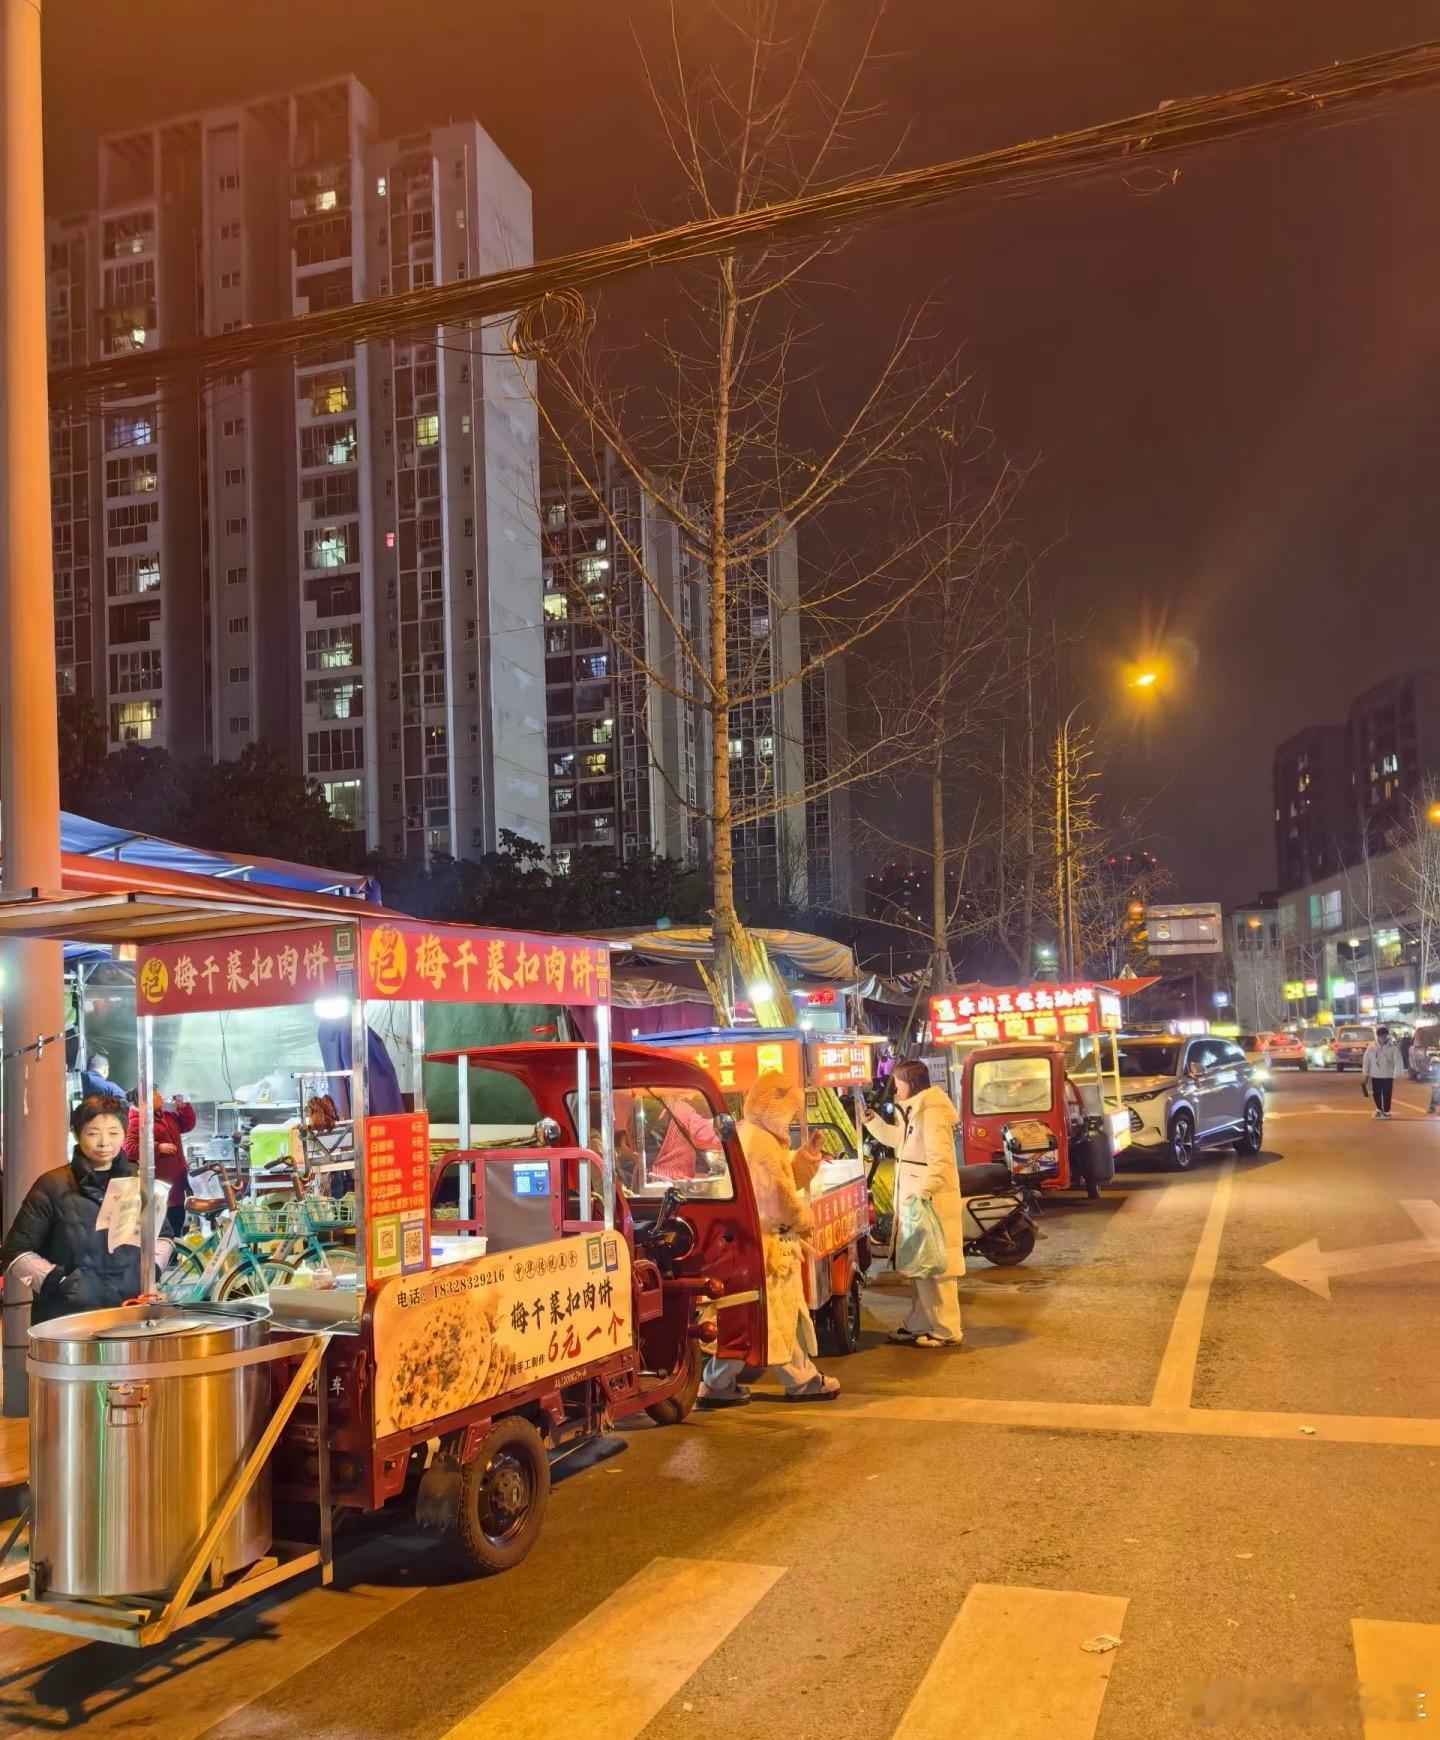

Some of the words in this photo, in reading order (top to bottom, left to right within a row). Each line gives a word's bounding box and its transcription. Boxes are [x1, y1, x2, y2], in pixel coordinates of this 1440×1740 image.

[174, 940, 329, 996] 梅干菜扣肉饼
[415, 933, 596, 998] 梅干菜扣肉饼
[432, 1268, 506, 1299] 18328329216
[510, 1275, 614, 1335] 梅干菜扣肉饼
[547, 1310, 625, 1363] 6元一个
